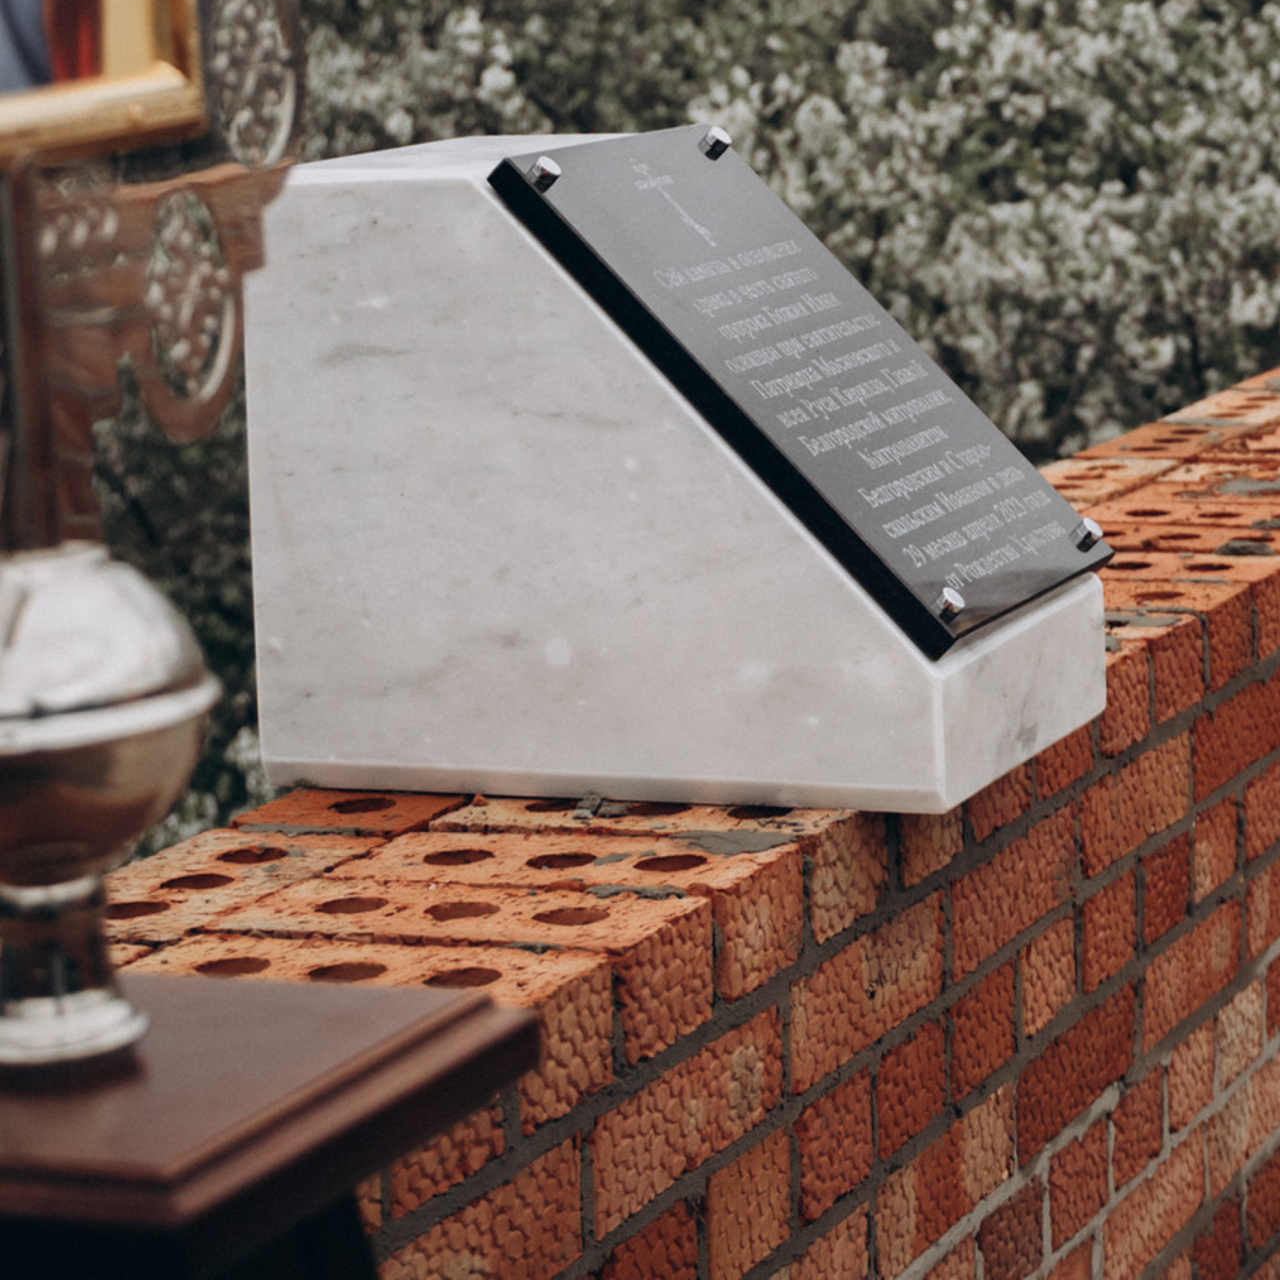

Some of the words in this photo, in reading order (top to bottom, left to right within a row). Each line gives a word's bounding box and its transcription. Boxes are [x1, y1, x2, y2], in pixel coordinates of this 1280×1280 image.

[738, 280, 775, 299] честь
[772, 267, 818, 290] святого
[719, 314, 772, 343] пророка
[761, 302, 810, 325] Божия
[726, 346, 781, 373] освящен
[776, 338, 806, 359] при
[802, 313, 880, 347] святительстве
[750, 366, 822, 399] Патриарха
[812, 342, 892, 376] Московского
[776, 407, 810, 429] всея
[799, 396, 840, 420] Руси
[830, 378, 894, 406] Кирилла,
[881, 359, 928, 387] Главой
[798, 411, 885, 458] Белгородской
[857, 425, 948, 469] Митрополитом
[857, 463, 944, 508] Белгородским
[883, 501, 945, 538] скольским
[935, 480, 993, 511] Иоанном
[923, 530, 967, 559] месяца
[963, 513, 1003, 540] апреля
[994, 496, 1026, 522] 2023
[1022, 490, 1052, 510] года
[954, 544, 1020, 581] Рождества
